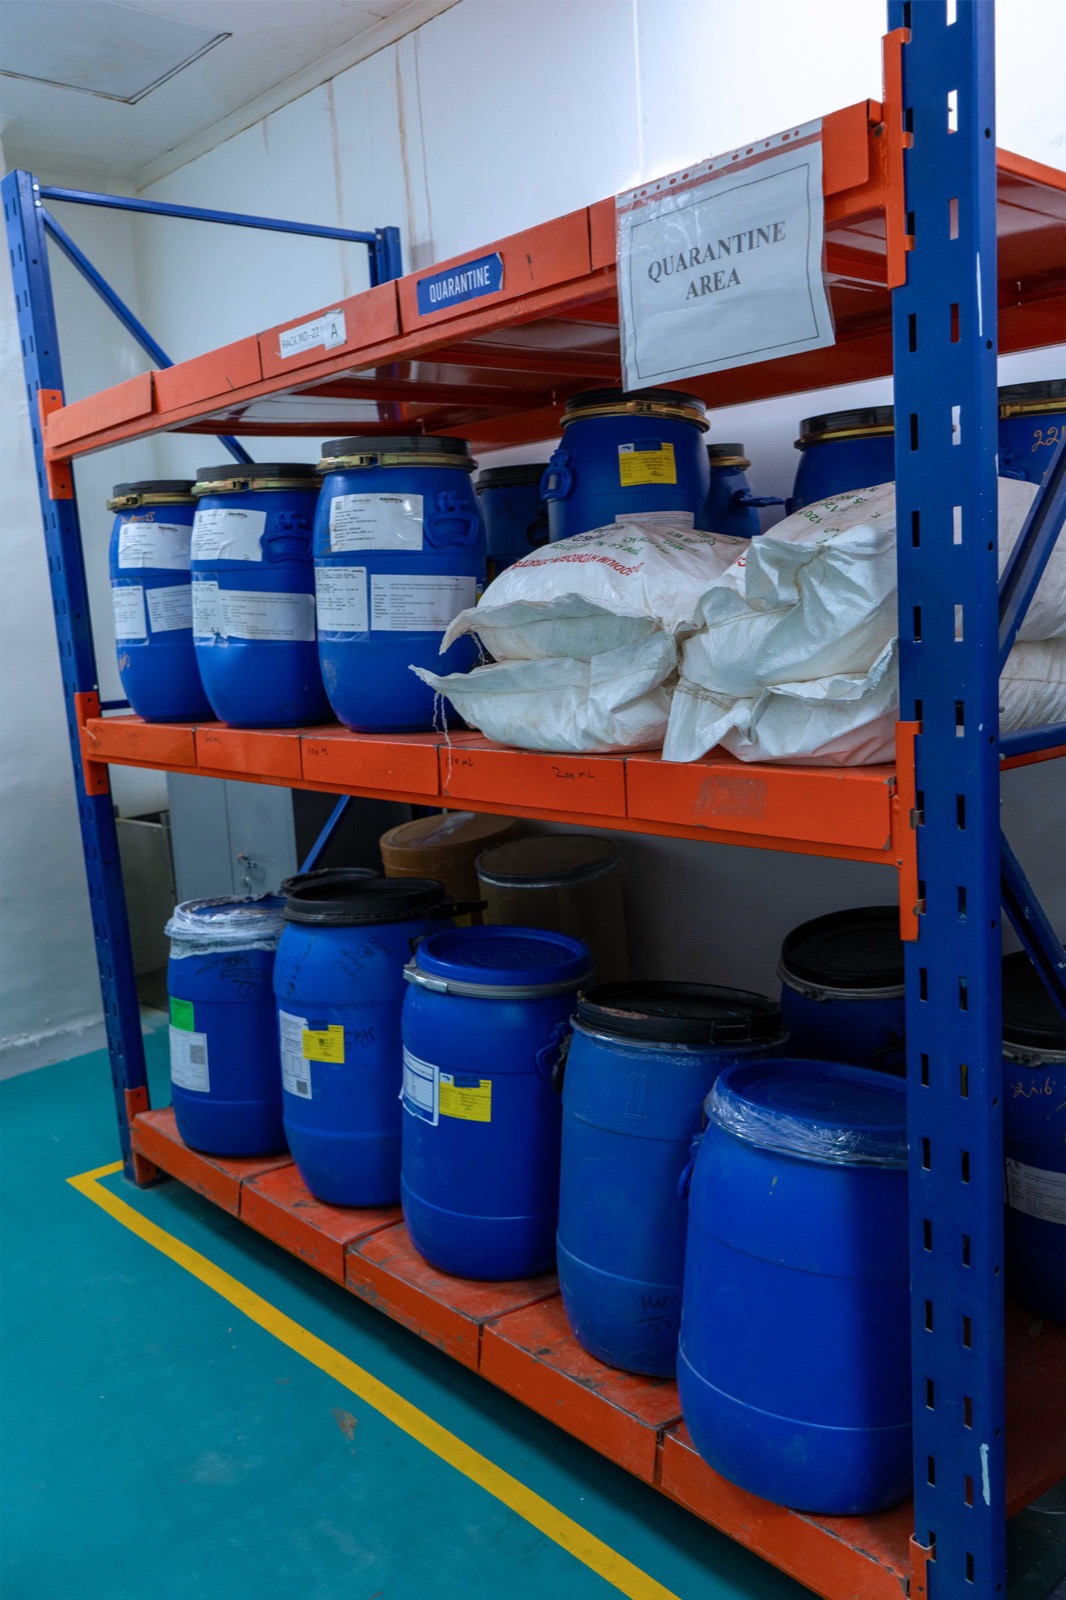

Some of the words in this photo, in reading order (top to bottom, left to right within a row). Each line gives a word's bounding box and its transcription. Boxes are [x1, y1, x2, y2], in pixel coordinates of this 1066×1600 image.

[648, 221, 786, 283] QUARANTINE
[429, 265, 491, 303] QUARANTINE
[685, 267, 742, 300] AREA
[330, 322, 339, 339] A
